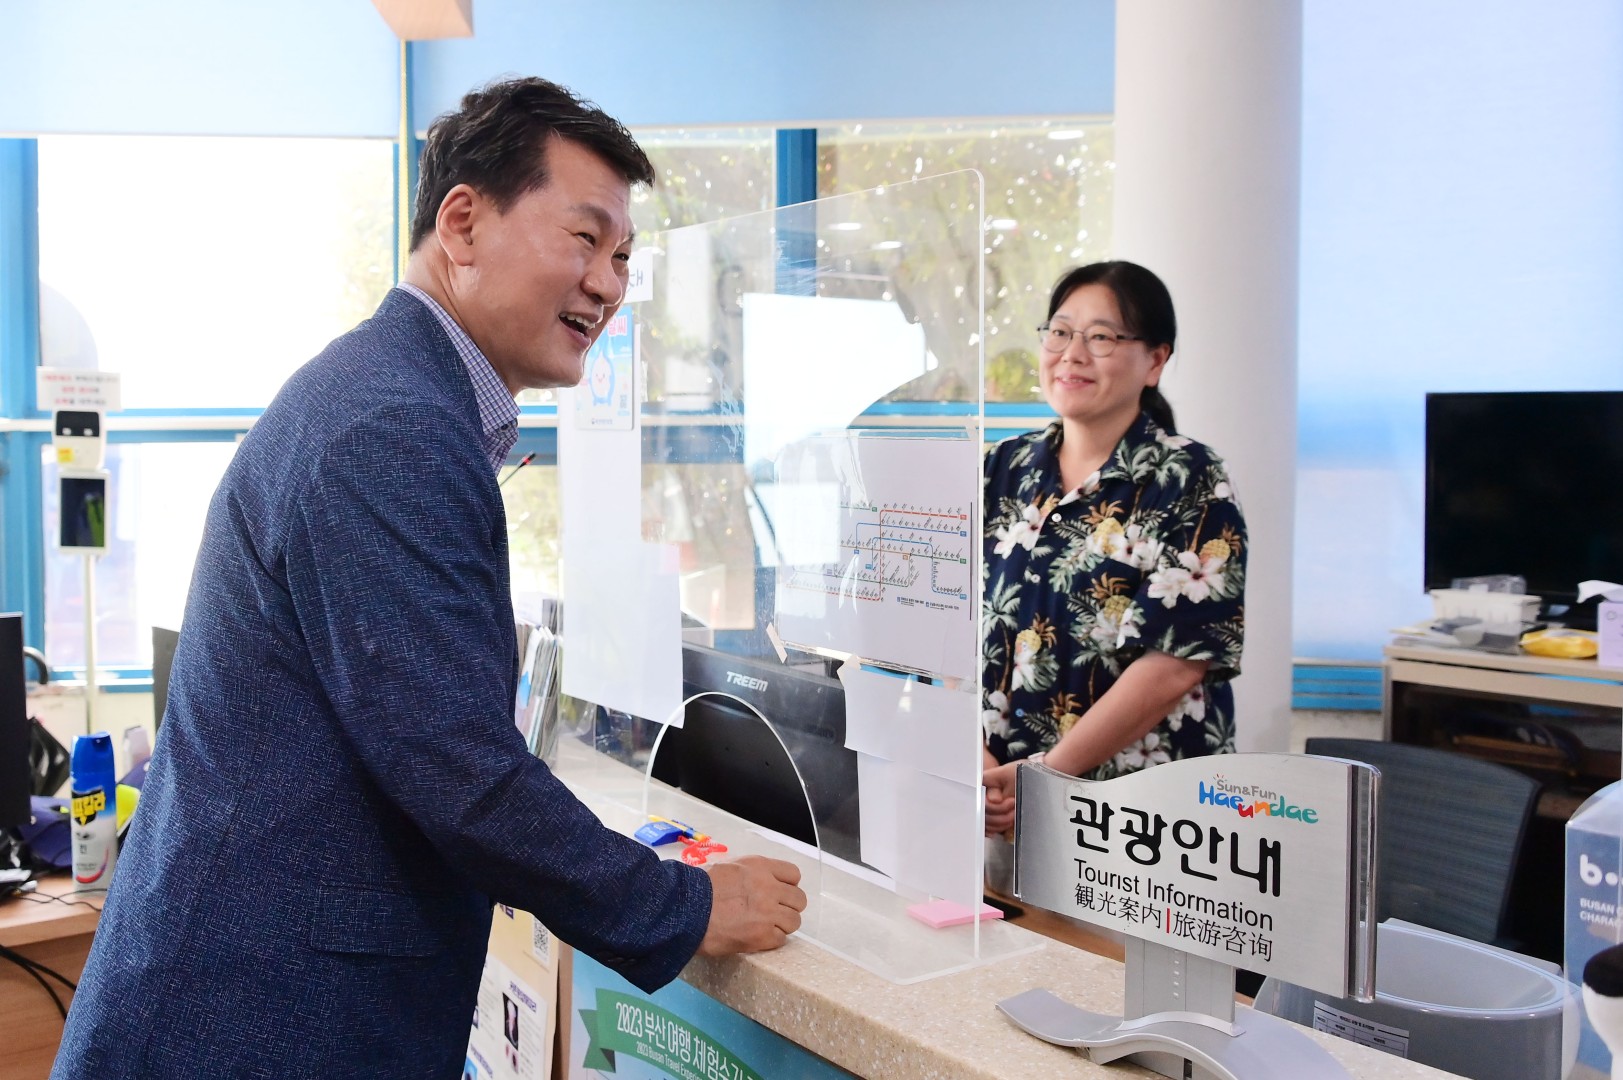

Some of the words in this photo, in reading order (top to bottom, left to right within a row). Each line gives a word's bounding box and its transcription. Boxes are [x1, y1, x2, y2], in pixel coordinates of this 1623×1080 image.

[726, 670, 769, 692] TREEM
[1198, 780, 1319, 824] Haeundae
[1216, 779, 1277, 801] Sun&Fun
[1069, 795, 1281, 898] 관광안내
[1074, 857, 1140, 896] Tourist
[1147, 877, 1273, 932] Information
[1580, 897, 1615, 915] BUSAN
[1074, 881, 1162, 930] 観光案内
[1172, 910, 1273, 963] 旅游咨询
[616, 1001, 643, 1038] 2023
[645, 1009, 666, 1050] 부산
[667, 1020, 691, 1063] 여행
[649, 1046, 665, 1065] Busan
[664, 1053, 681, 1073] Travel
